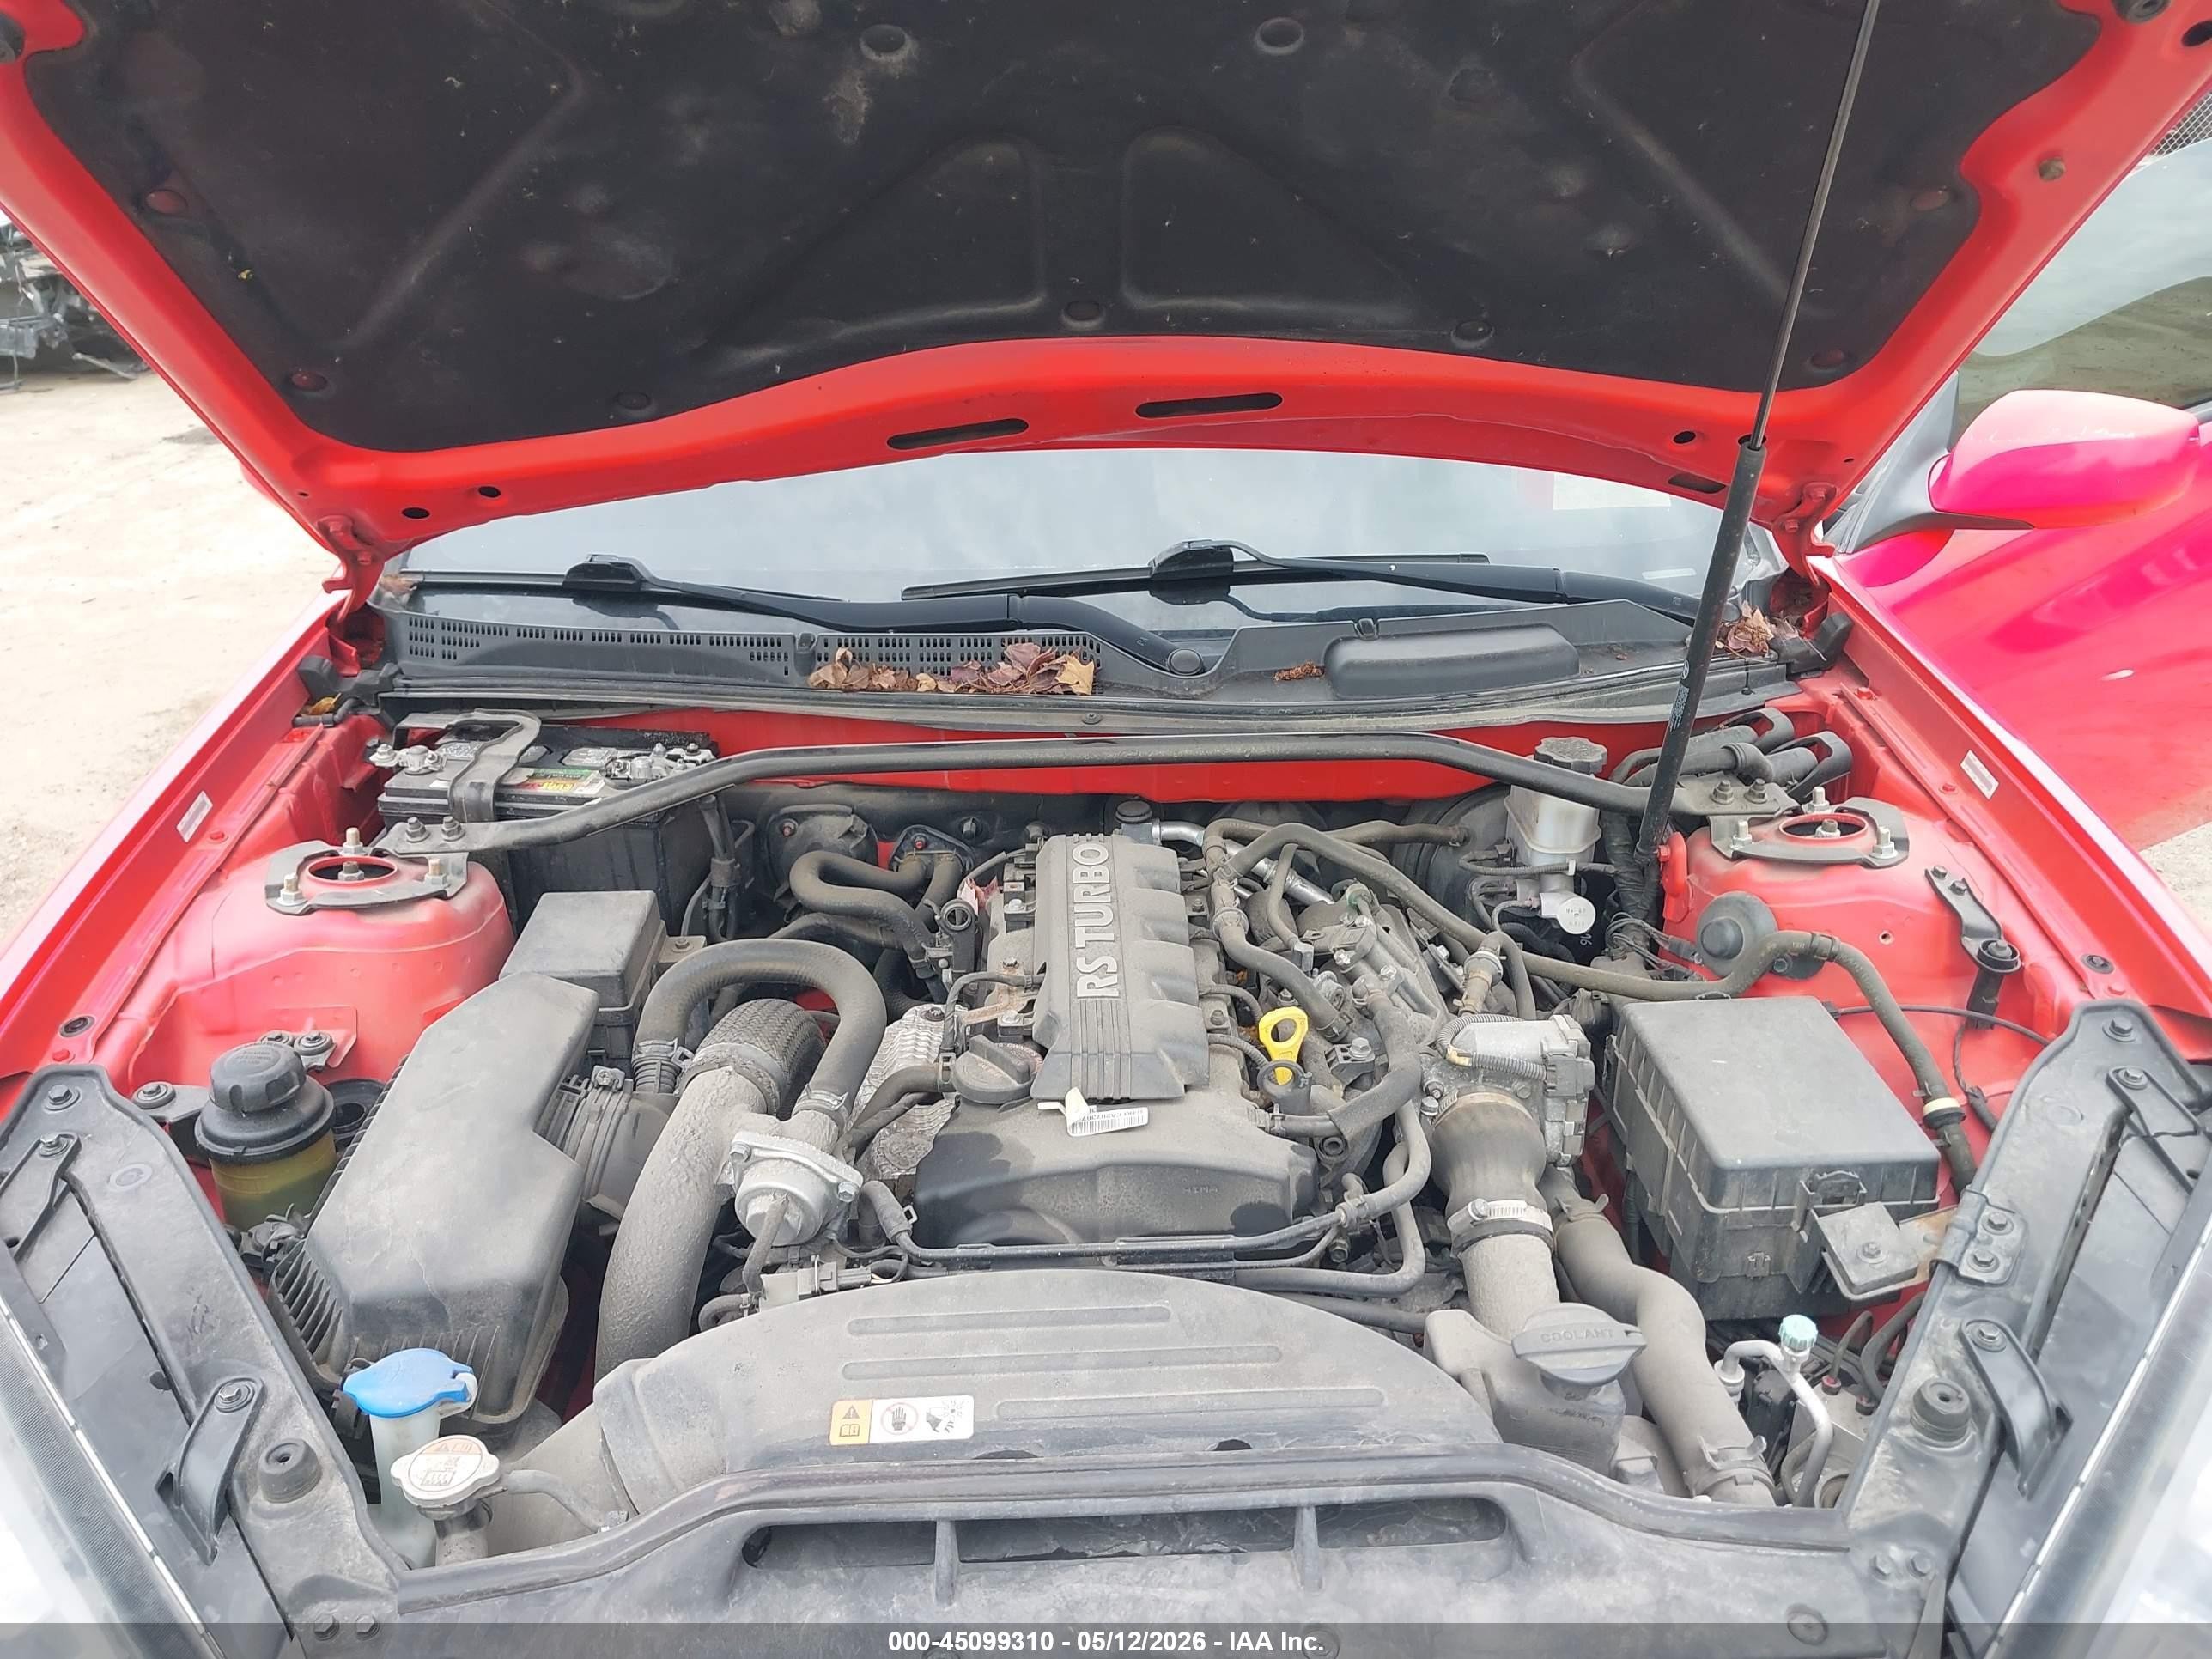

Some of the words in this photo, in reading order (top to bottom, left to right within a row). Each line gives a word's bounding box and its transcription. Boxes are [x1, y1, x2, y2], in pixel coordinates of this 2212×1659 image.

[1073, 843, 1115, 949] TURBO
[1076, 955, 1120, 999] RS
[1540, 1328, 1614, 1344] COOLANT
